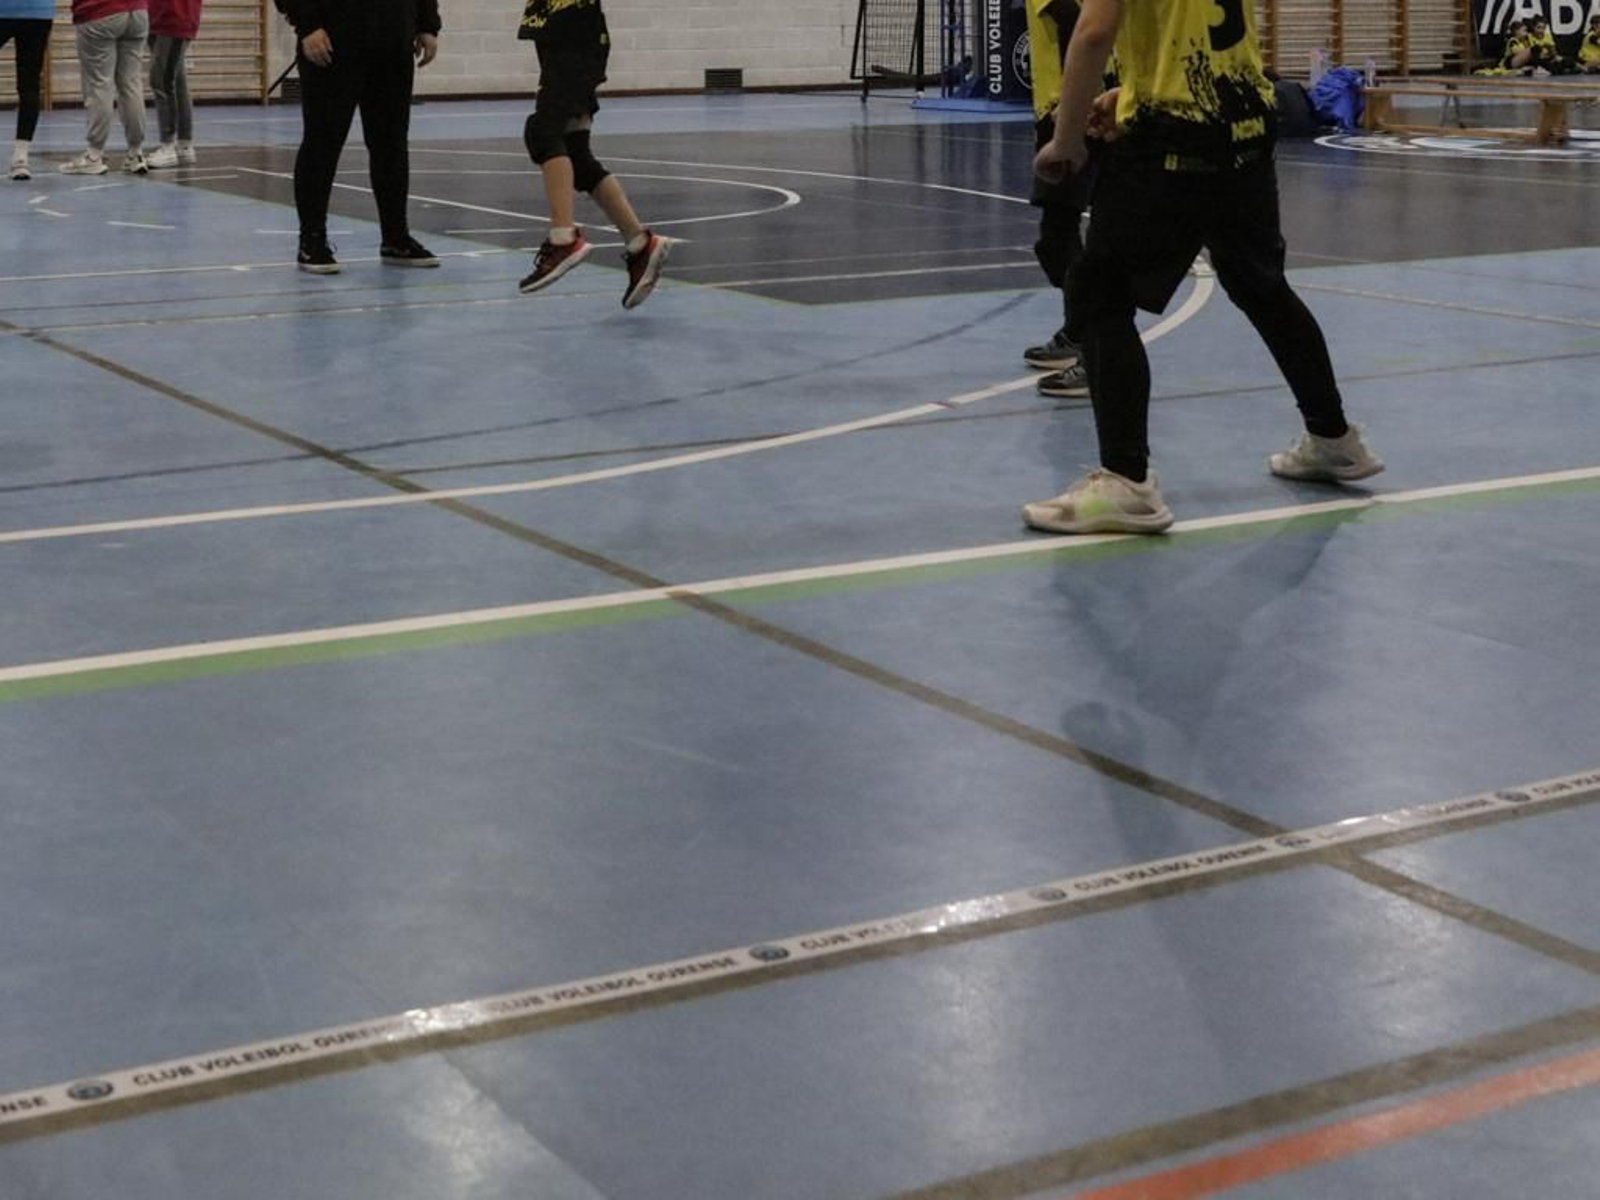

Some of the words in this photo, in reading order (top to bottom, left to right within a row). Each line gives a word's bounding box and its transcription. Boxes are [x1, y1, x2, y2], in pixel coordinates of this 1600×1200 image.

[988, 53, 1002, 95] CLUB
[647, 955, 738, 982] OURENSE
[133, 1065, 193, 1088] CLUB
[200, 1042, 309, 1074] VOLEIBOL
